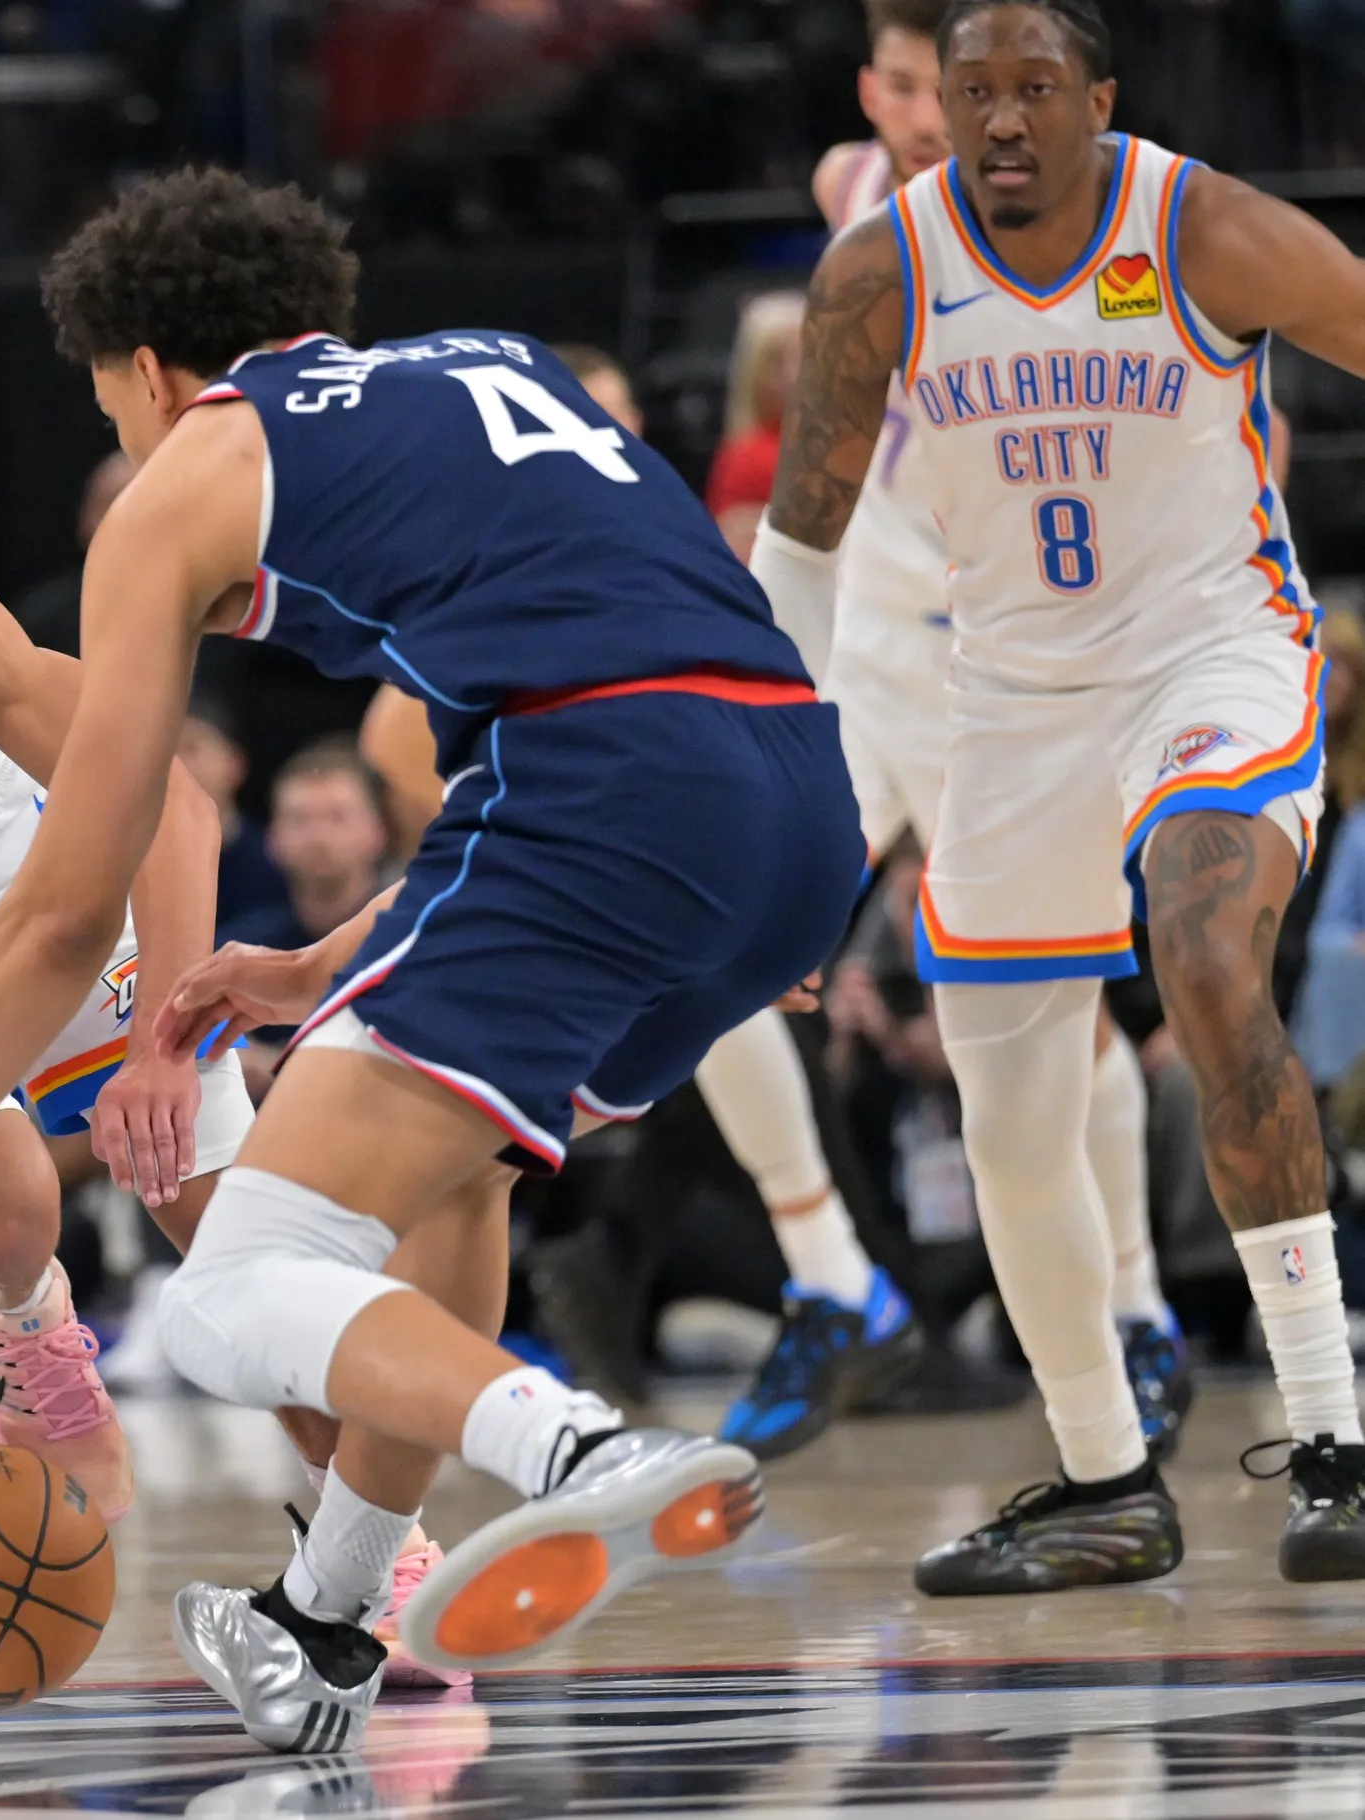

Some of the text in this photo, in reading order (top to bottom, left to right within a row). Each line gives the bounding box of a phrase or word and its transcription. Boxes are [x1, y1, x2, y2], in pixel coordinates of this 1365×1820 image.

[443, 364, 640, 483] 4
[914, 351, 1189, 429] OKLAHOMA
[995, 424, 1111, 485] CITY
[1031, 490, 1102, 597] 8
